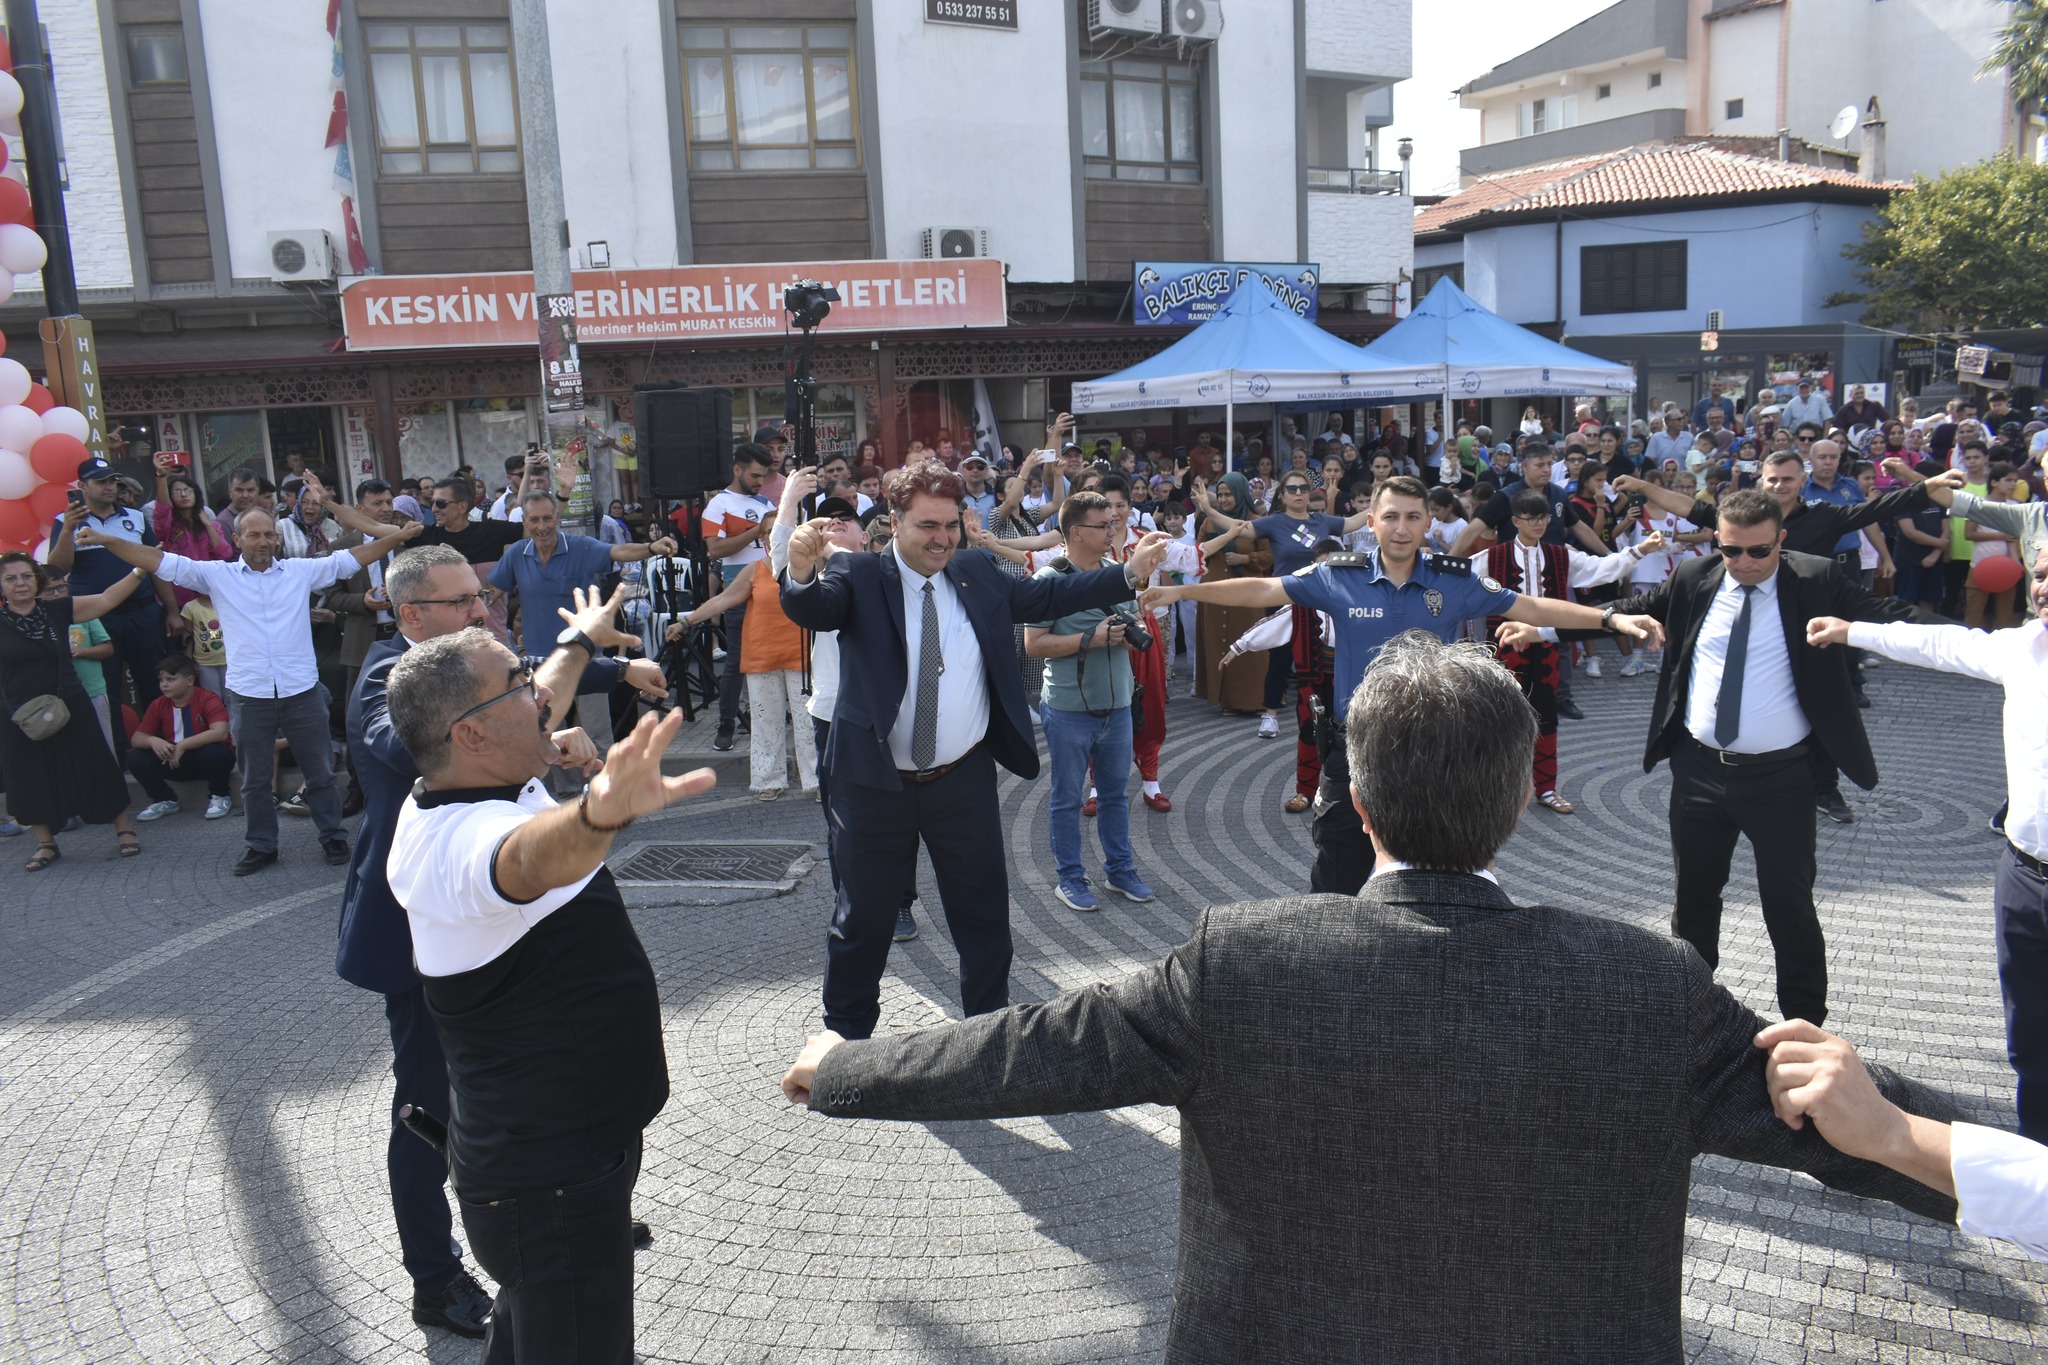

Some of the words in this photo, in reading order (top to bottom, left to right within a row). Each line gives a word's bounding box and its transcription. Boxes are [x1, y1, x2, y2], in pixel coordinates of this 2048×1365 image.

[936, 1, 943, 15] 0
[945, 2, 963, 17] 533
[965, 4, 983, 19] 237
[985, 6, 997, 20] 55
[999, 8, 1010, 22] 51
[365, 286, 499, 326] KESKİN
[506, 276, 760, 321] VERİNERLİK
[768, 269, 967, 310] HMETLERİ
[1145, 271, 1229, 318] BALIKÇI
[1237, 269, 1309, 318] EDİNÇ
[637, 322, 678, 333] Hekim
[680, 318, 726, 331] MURAT
[729, 313, 776, 329] KESKİN
[550, 361, 560, 374] 8
[776, 423, 838, 440] KEKİN
[1348, 607, 1384, 618] POLİS
